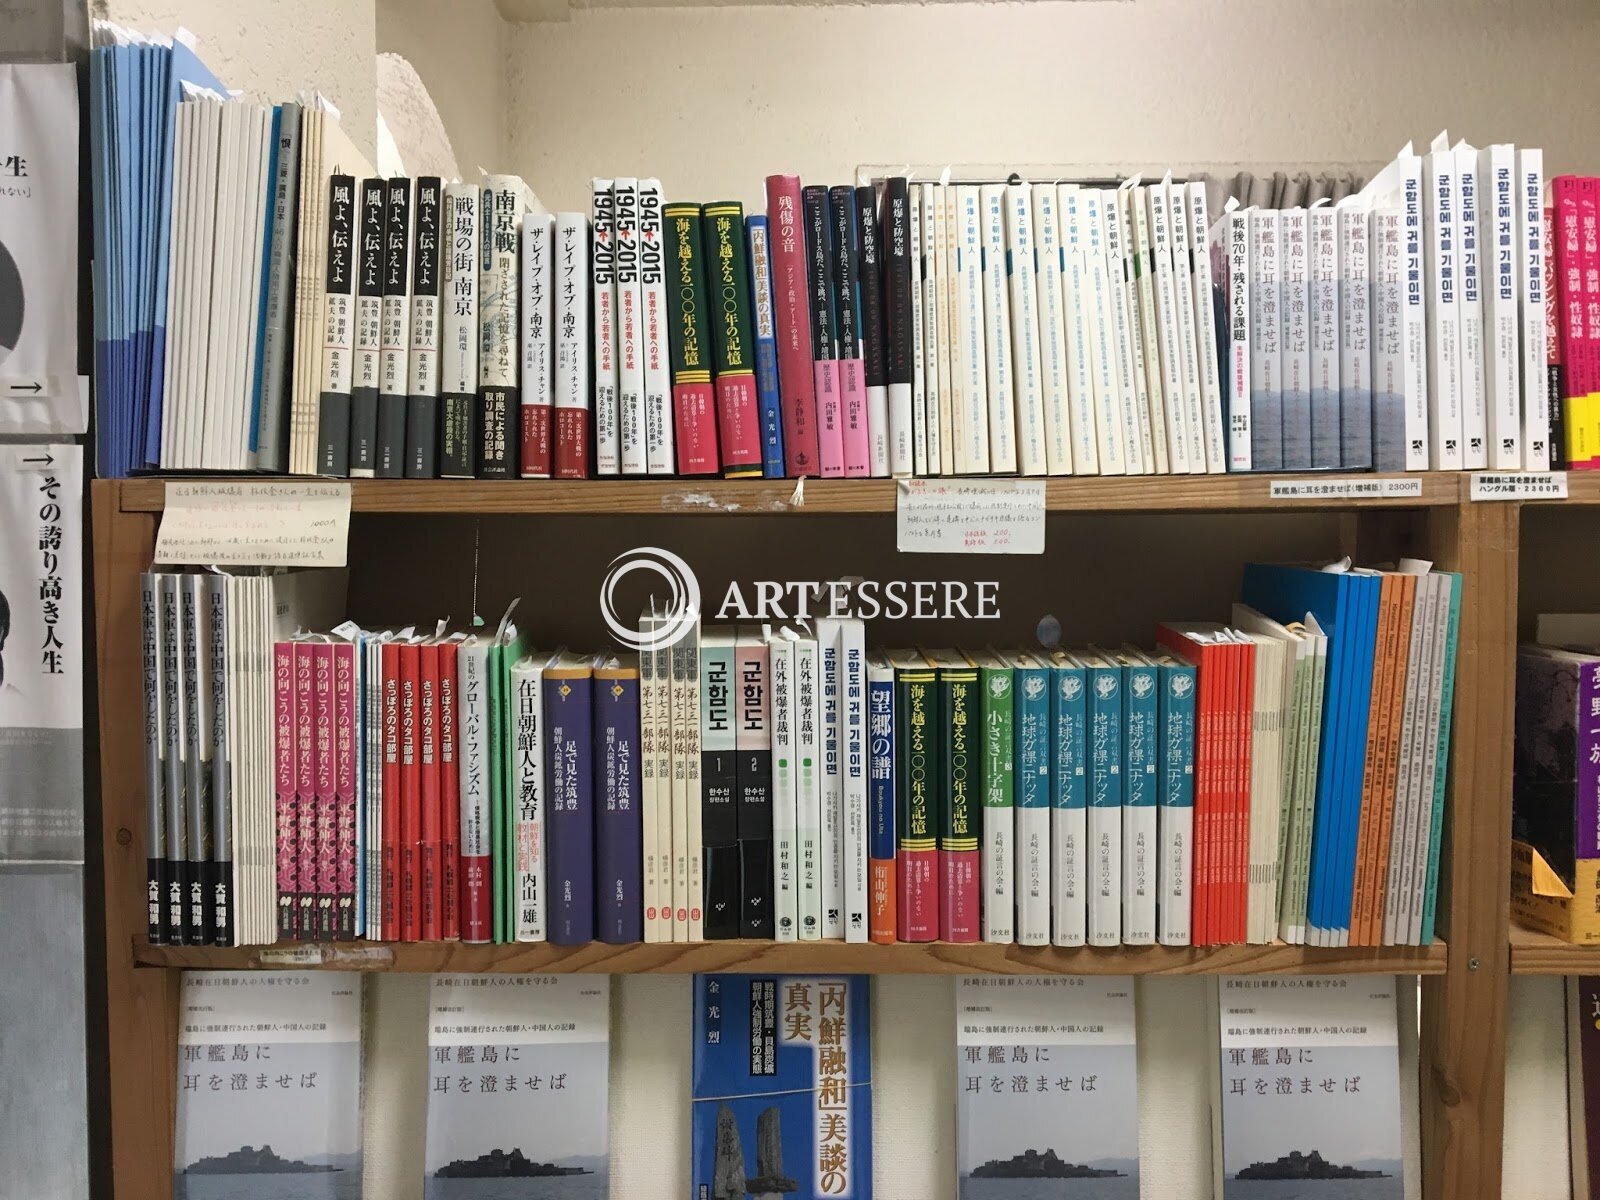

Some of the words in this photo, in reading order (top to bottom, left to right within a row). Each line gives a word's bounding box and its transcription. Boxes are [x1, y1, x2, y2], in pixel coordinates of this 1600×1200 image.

[495, 189, 516, 254] 南京戦
[594, 187, 613, 232] 1945
[616, 186, 635, 231] 1945
[639, 187, 658, 232] 1945
[778, 196, 795, 253] 残傷の音
[893, 198, 904, 257] 原爆と防空壕
[1405, 179, 1418, 226] 군함도에
[1438, 175, 1451, 223] 군함도에
[1462, 174, 1475, 221] 군함도에
[1498, 168, 1510, 217] 군함도에
[1527, 173, 1539, 222] 군함도에
[332, 186, 350, 284] 風よ、伝えよ
[364, 188, 382, 286] 風よ、伝えよ
[387, 187, 405, 285] 風よ、伝えよ
[418, 187, 436, 285] 風よ、伝えよ
[454, 196, 474, 272] 戦場の街
[595, 241, 614, 284] 2015
[618, 240, 637, 283] 2015
[641, 240, 661, 284] 2015
[862, 207, 875, 264] 原爆と防空壕
[454, 277, 473, 317] 南京
[529, 227, 545, 339] ザ・レイプ・オブ・南京
[561, 227, 576, 339] ザ・レイプ・オブ・南京
[676, 217, 699, 366] 海を越える一〇〇年の記憶
[716, 216, 742, 366] 海を越える一〇〇年の記憶
[1232, 217, 1246, 341] 戦後70年・残される課題
[1262, 216, 1277, 353] 軍艦島に耳を澄ませば
[1290, 215, 1305, 353] 軍艦島に耳を澄ませば
[1320, 214, 1335, 352] 軍艦島に耳を澄ませば
[1351, 212, 1366, 350] 軍艦島に耳を澄ませば
[1385, 214, 1399, 354] 軍艦島に耳を澄ませば
[499, 257, 511, 378] 閉ざされた記憶を尋ねて
[600, 292, 611, 370] 若者から若者への手紙
[623, 290, 634, 370] 若者から若者への手紙
[648, 291, 659, 370] 若者から若者への手紙
[484, 391, 494, 461] 取り調査の記録
[494, 391, 505, 460] 市民による聞き
[1388, 482, 1419, 492] 2300円
[39, 476, 64, 674] その誇り高き人生
[142, 590, 156, 745] 日本軍は中国で何をしたのか
[163, 592, 178, 747] 日本軍は中国で何をしたのか
[182, 592, 197, 746] 日本軍は中国で何をしたのか
[210, 592, 225, 747] 日本軍は中国で何をしたのか
[708, 660, 729, 731] 군함도
[743, 660, 763, 731] 군함도
[775, 658, 789, 746] 在外被爆者裁判
[799, 657, 813, 745] 在外被爆者裁判
[824, 648, 836, 696] 군함도에
[848, 649, 860, 697] 군함도에
[275, 654, 290, 788] 海の向こうの被爆者たち
[297, 654, 311, 787] 海の向こうの被爆者たち
[316, 655, 330, 788] 海の向こうの被爆者たち
[336, 654, 351, 788] 海の向こうの被爆者たち
[386, 679, 397, 764] さっぽろのタコ部屋
[402, 680, 414, 765] さっぽろのタコ部屋
[422, 680, 433, 765] さっぽろのタコ部屋
[441, 678, 453, 763] さっぽろのタコ部屋
[465, 656, 480, 796] 21世紀のグローバル・ファシズム
[517, 679, 537, 821] 在日朝鮮人と教育
[870, 690, 890, 780] 望郷の譜
[987, 710, 1003, 803] 小さき十字架
[1093, 712, 1108, 804] 地球ガ裸ニナッタ
[1128, 712, 1144, 804] 地球ガ裸ニナッタ
[1167, 711, 1182, 804] 地球ガ裸ニナッタ
[565, 740, 578, 811] 足で見た筑豊
[617, 740, 630, 811] 足で見た筑豊
[688, 760, 699, 780] 実録
[708, 787, 730, 797] 한수산
[716, 757, 721, 772] 1
[743, 787, 765, 797] 한수산
[751, 757, 758, 772] 2
[910, 685, 926, 834] 海を越える一〇〇年の記憶
[952, 684, 968, 834] 海を越える一〇〇年の記憶
[1022, 713, 1037, 805] 地球ガ裸ニナッタ
[1058, 714, 1073, 806] 地球ガ裸ニナッタ
[522, 873, 538, 923] 内山一雄
[804, 840, 813, 881] 田村和之
[186, 977, 310, 987] 長崎在日朝鮮人の人権を守る会
[436, 976, 558, 987] 長崎在日朝鮮人の人権を守る会
[708, 981, 720, 1044] 金光烈
[784, 982, 812, 1041] 真実
[963, 978, 1084, 987] 長崎在日朝鮮人の人権を守る会
[1226, 979, 1347, 988] 長崎在日朝鮮人の人権を守る会
[184, 1044, 271, 1062] 軍艦島に
[434, 1045, 520, 1064] 軍艦島に
[752, 982, 762, 1074] 朝鮮人強制労働の実態
[965, 1045, 1049, 1064] 軍艦島に
[1229, 1047, 1313, 1066] 軍艦島に
[183, 1072, 317, 1092] 耳を澄ませば
[433, 1073, 567, 1094] 耳を澄ませば
[818, 982, 847, 1195] 「内鮮融和」美談の
[965, 1074, 1098, 1094] 耳を澄ませば
[1230, 1076, 1361, 1096] 耳を澄ませば
